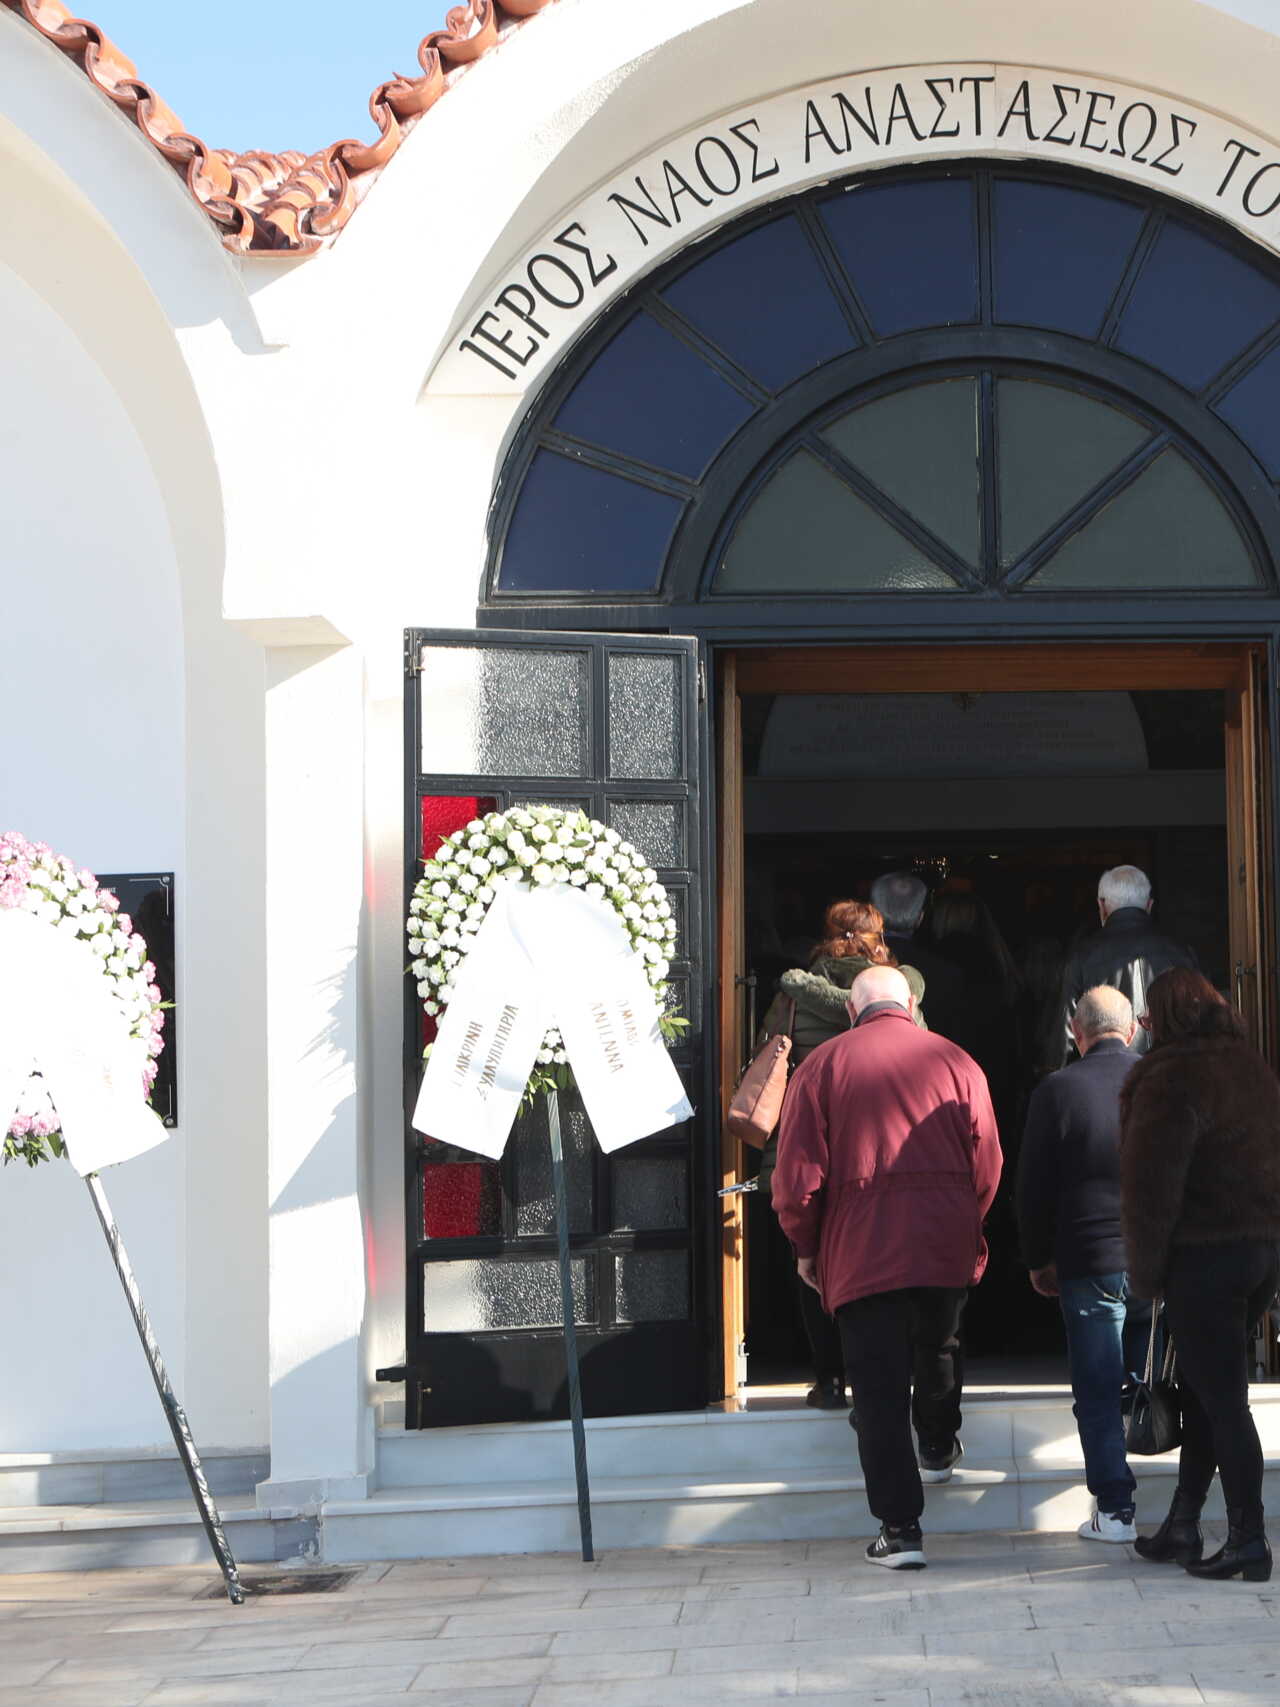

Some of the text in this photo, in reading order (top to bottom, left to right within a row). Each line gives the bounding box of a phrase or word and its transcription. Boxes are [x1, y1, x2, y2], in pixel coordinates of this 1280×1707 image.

[459, 222, 618, 380] ΙΕΡΟΣ
[607, 118, 780, 246] ΝΑΟΣ
[804, 76, 1197, 176] ΑΝΑΣΤΑΣΕΩΣ
